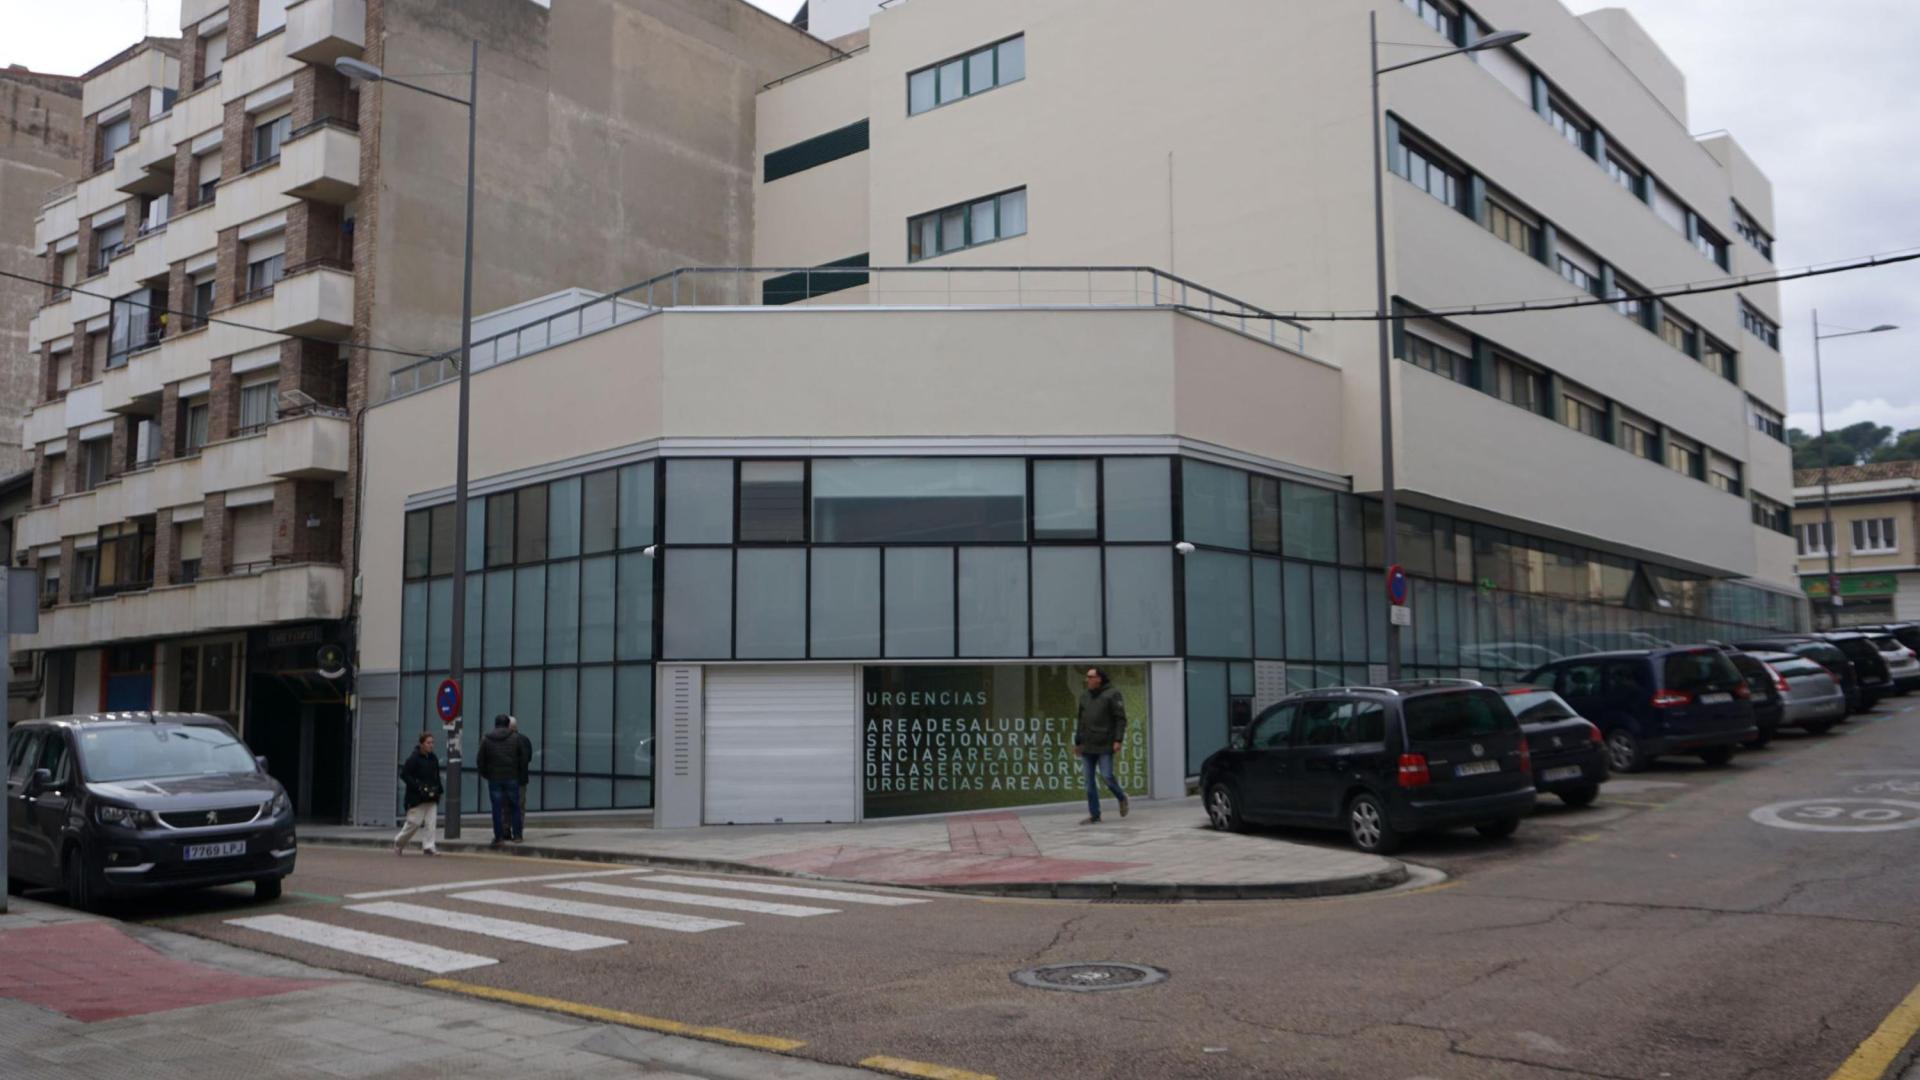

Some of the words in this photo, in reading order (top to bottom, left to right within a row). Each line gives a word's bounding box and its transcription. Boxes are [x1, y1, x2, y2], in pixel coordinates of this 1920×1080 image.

[866, 691, 987, 706] URGENCIAS
[1794, 806, 1903, 821] 30
[192, 845, 220, 857] 7769
[223, 842, 244, 855] LPJ
